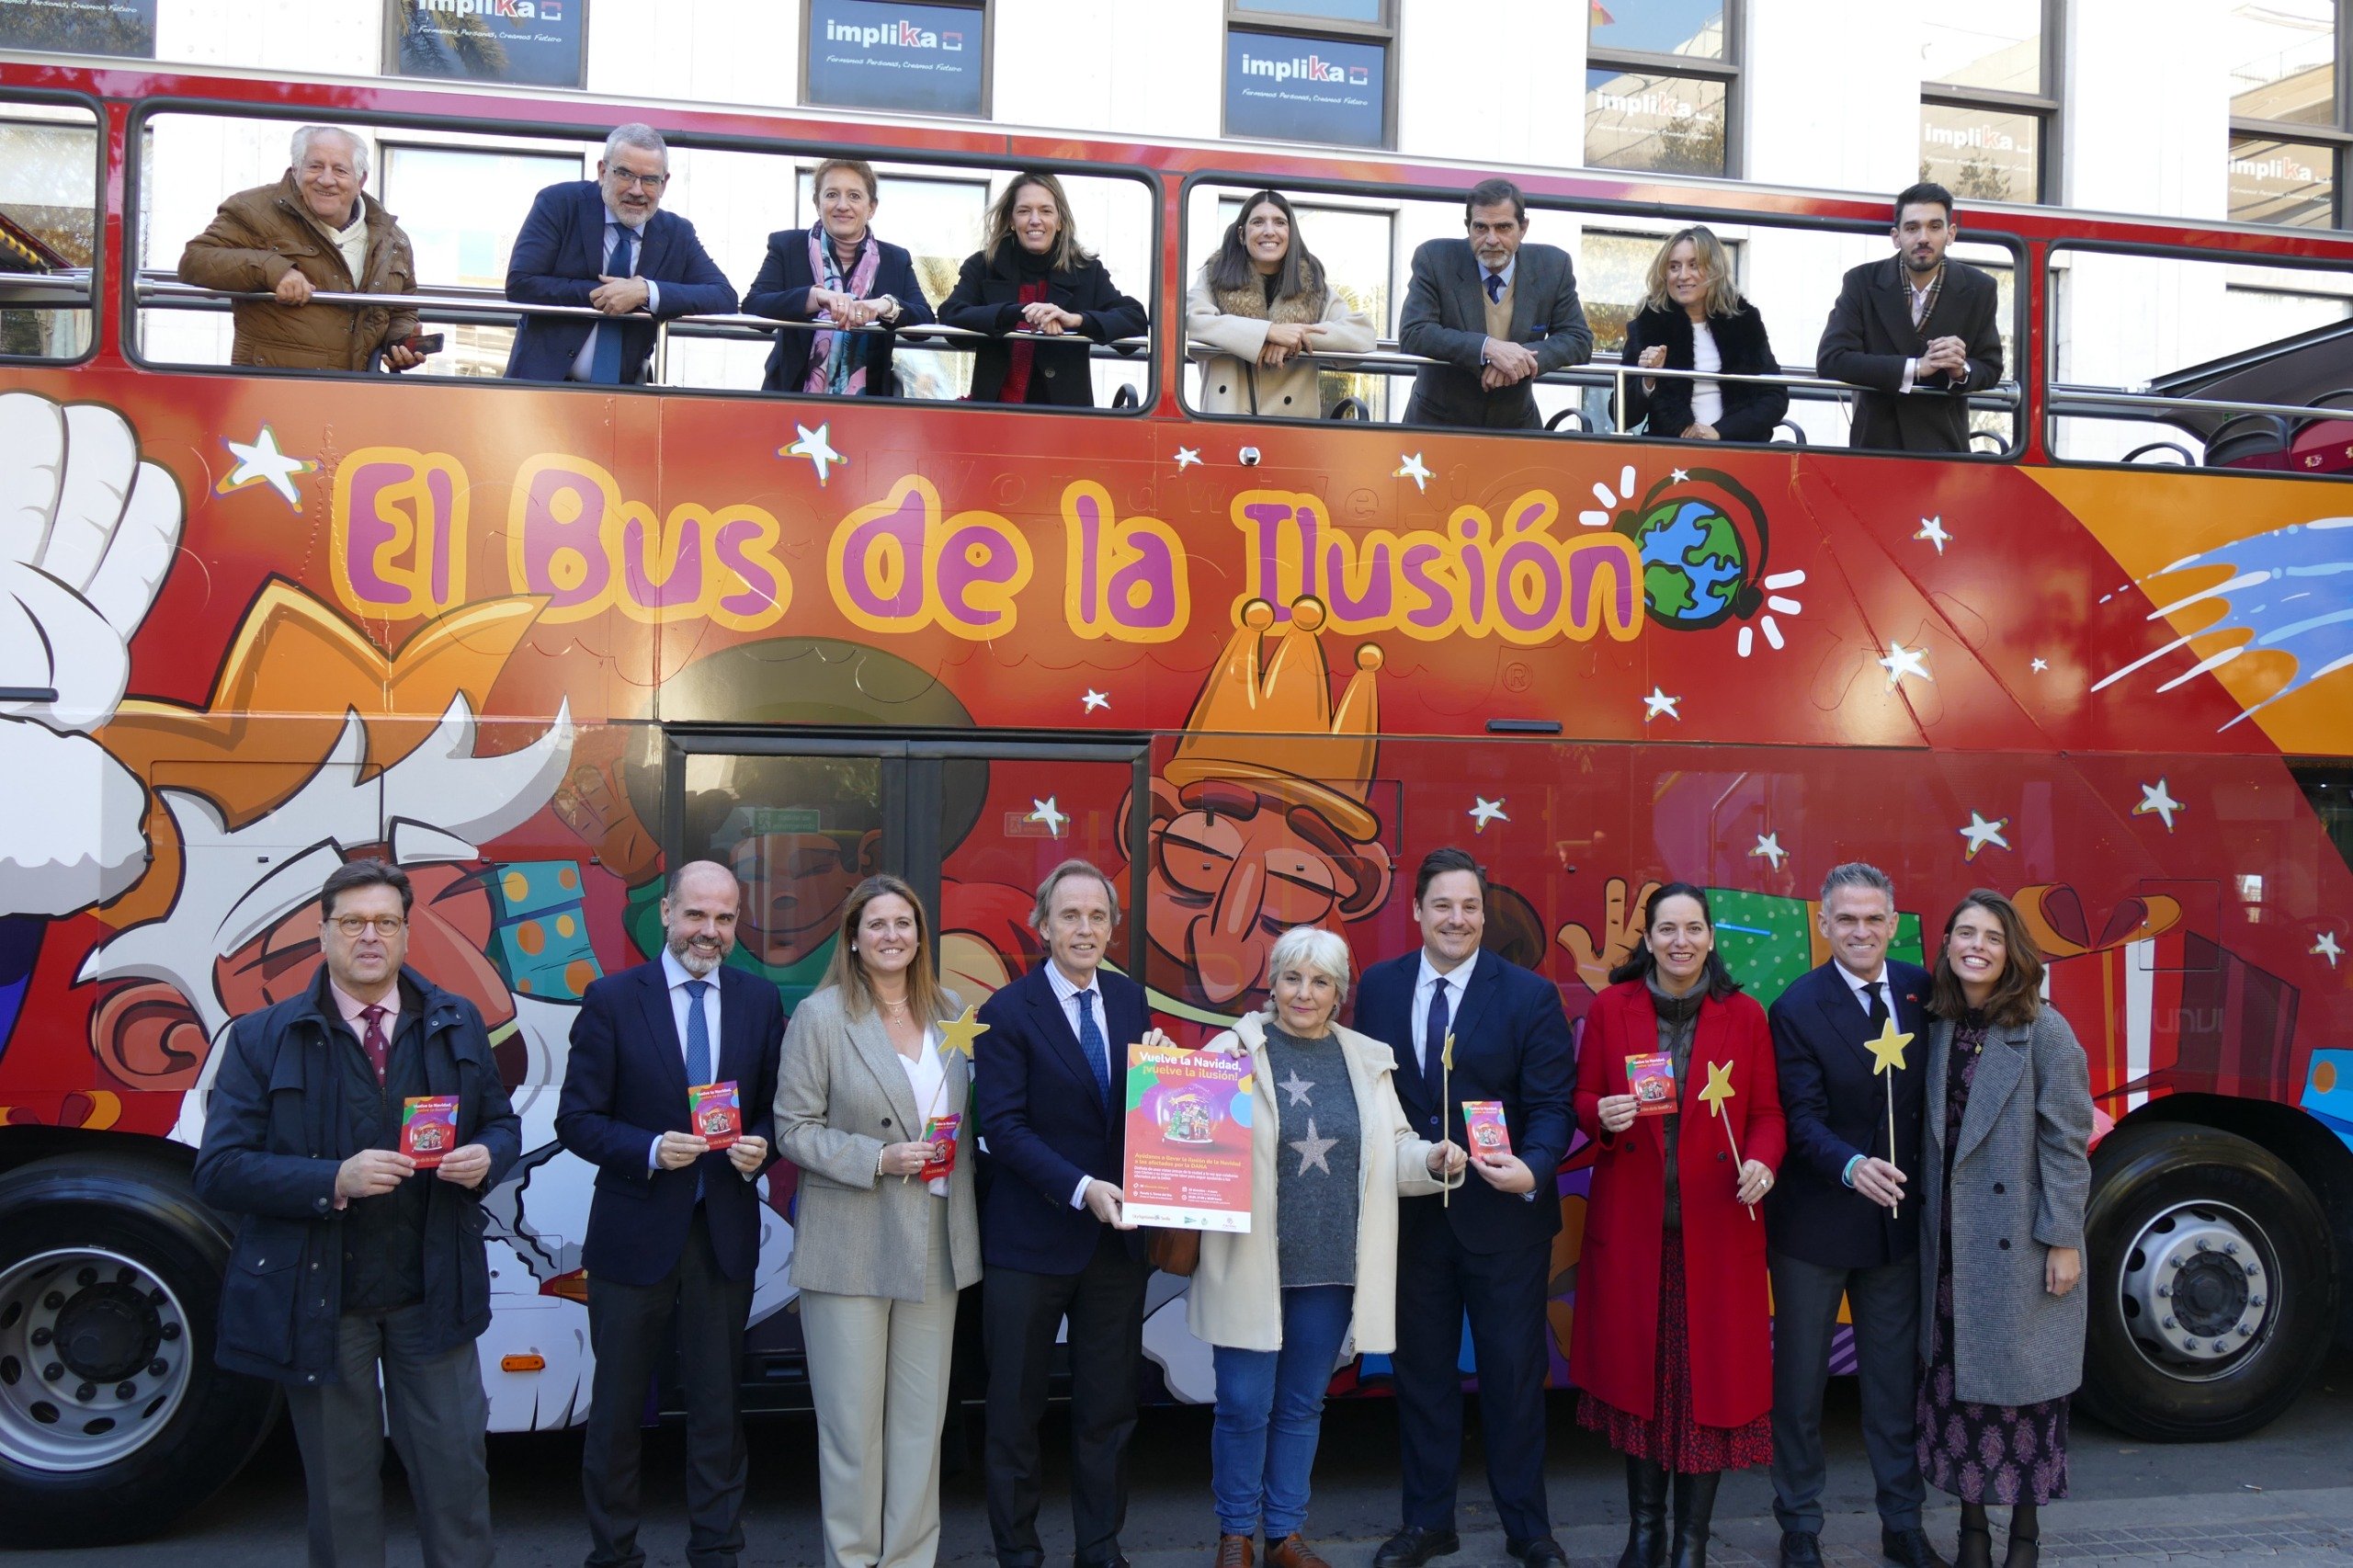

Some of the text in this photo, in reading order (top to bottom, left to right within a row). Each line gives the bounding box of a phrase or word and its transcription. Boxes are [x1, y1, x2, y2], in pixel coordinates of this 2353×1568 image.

[72, 2, 105, 11] Creamos
[108, 5, 138, 14] Futuro
[460, 28, 497, 40] Personas,
[499, 31, 531, 41] Creamos
[534, 33, 563, 42] Futuro
[827, 19, 938, 48] implika
[826, 55, 962, 73] Formamos Personas, Creamos Futuro
[1243, 53, 1345, 82] implika
[1242, 88, 1369, 106] Formamos Personas, Creamos Futuro
[1596, 89, 1691, 118] implika
[1925, 123, 2014, 151] implika
[2230, 155, 2312, 182] implika
[329, 447, 1645, 644] El Bus de la Ilusión
[1140, 1051, 1242, 1073] Vuelve la Navidad,
[1142, 1065, 1238, 1082] ¡vuelve la ilusión!
